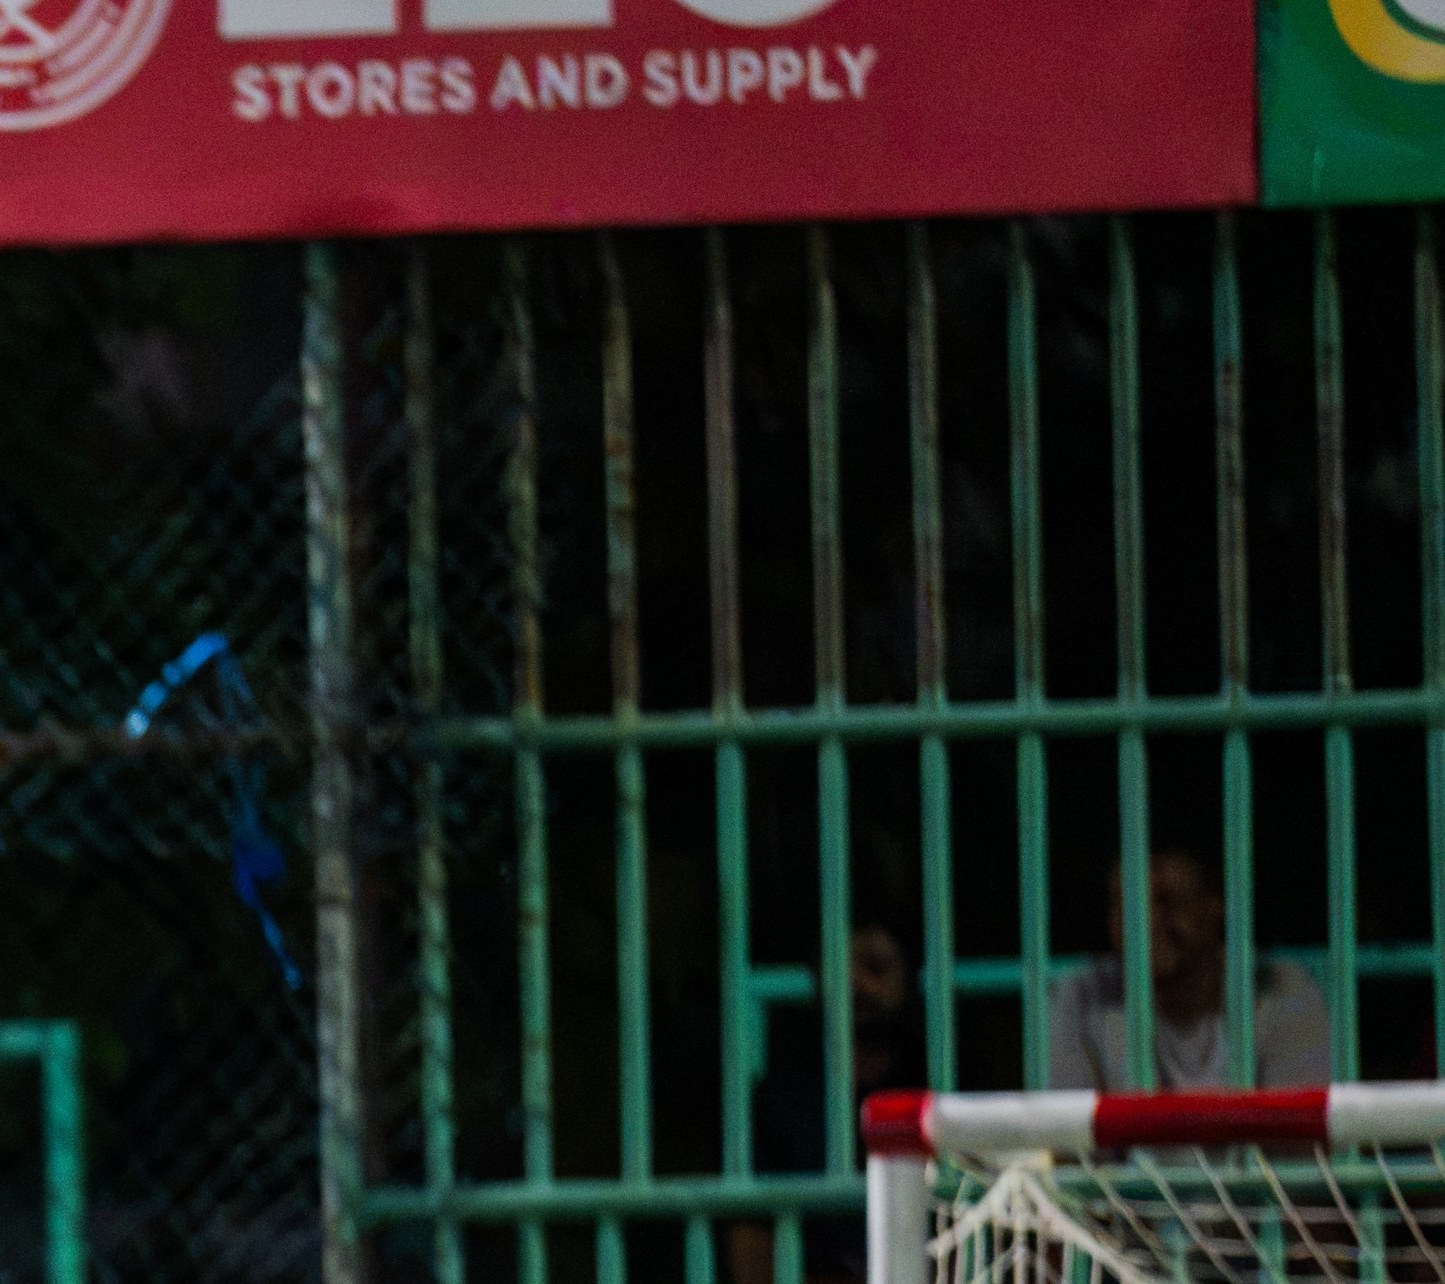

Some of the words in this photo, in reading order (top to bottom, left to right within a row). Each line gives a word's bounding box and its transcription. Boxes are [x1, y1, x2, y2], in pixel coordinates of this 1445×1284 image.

[232, 57, 475, 120] STORES
[489, 53, 631, 111] AND
[641, 44, 878, 105] SUPPLY
